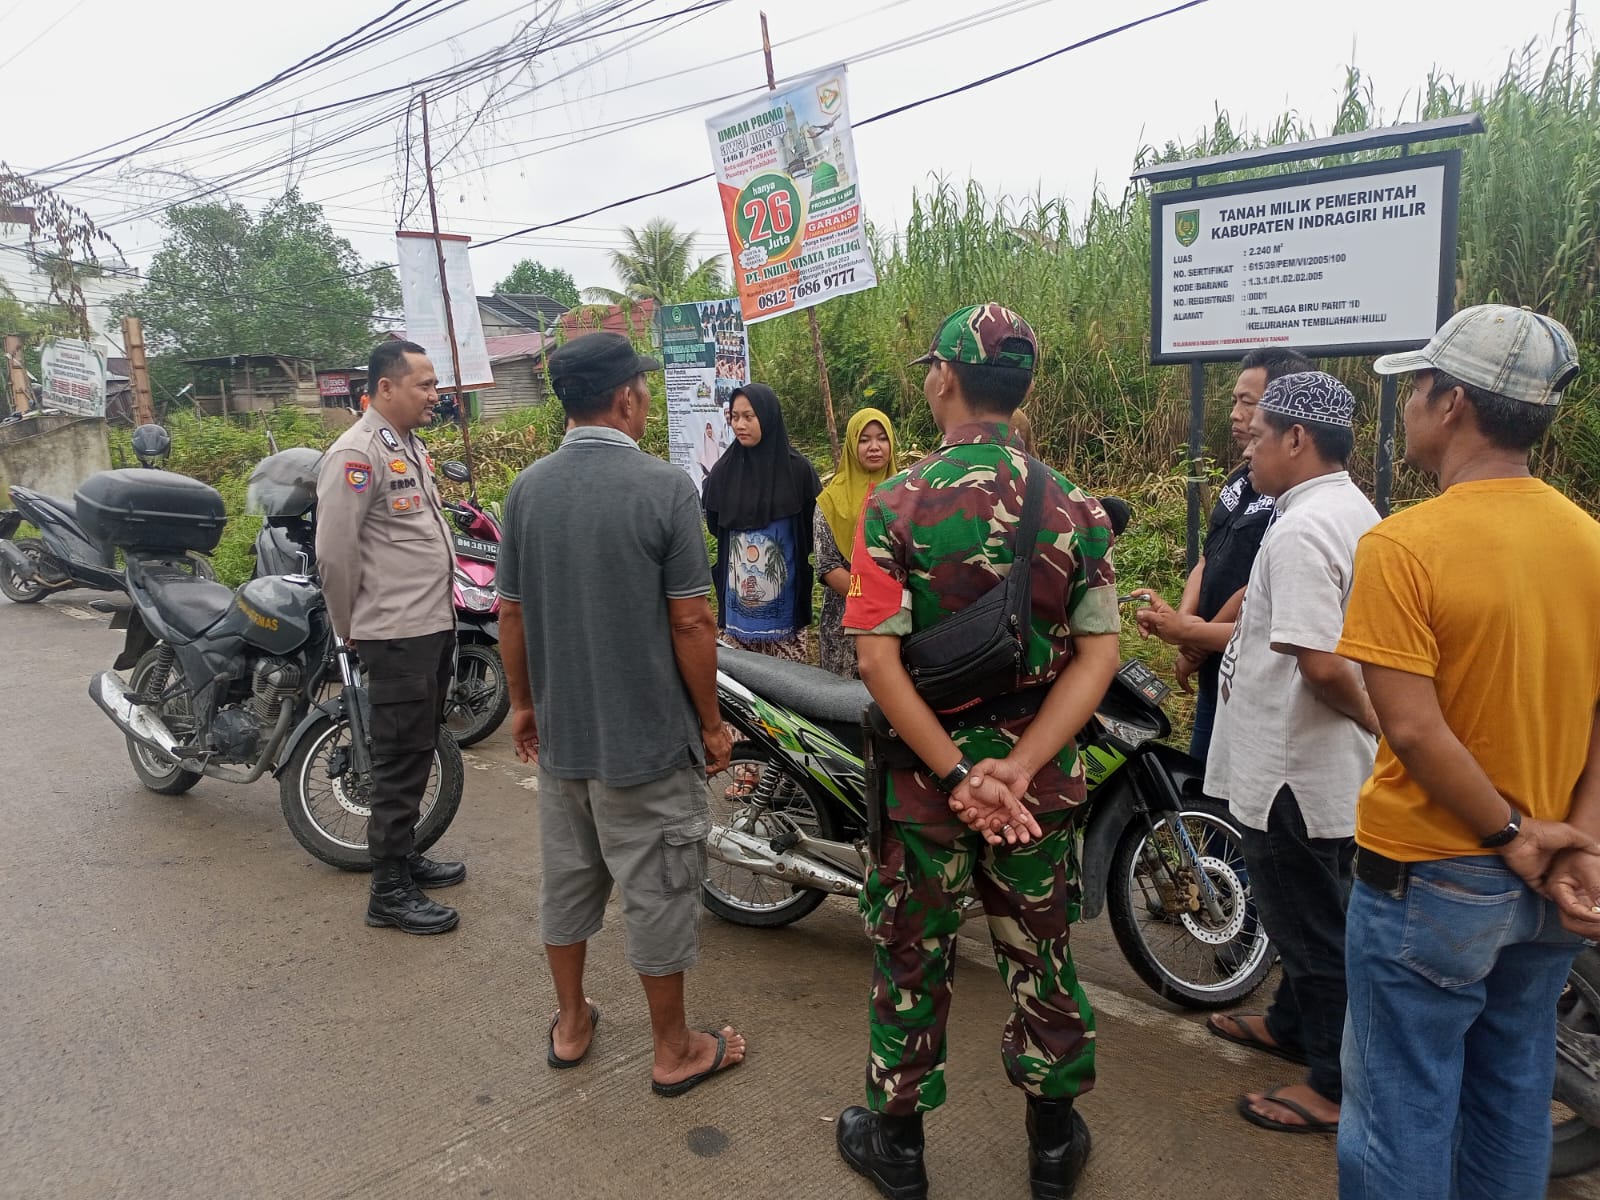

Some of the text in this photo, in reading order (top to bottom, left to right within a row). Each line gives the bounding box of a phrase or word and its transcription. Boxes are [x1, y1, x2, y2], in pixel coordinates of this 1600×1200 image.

[717, 106, 784, 143] UMRAH PROMO
[749, 121, 787, 145] musim
[752, 182, 776, 196] hanya
[811, 196, 837, 210] PROGRAM
[1219, 184, 1417, 222] TANAH MILIK PEMERINTAH
[743, 189, 793, 244] 26
[808, 208, 856, 232] GARANSI
[1211, 202, 1426, 240] KABUPATEN INDRAGIRI HILIR
[768, 235, 790, 250] Juta
[745, 271, 761, 285] PT.
[763, 262, 789, 280] INHIL
[791, 250, 824, 271] WISATA
[827, 239, 861, 258] RELIGI
[1173, 254, 1193, 264] LUAS
[1248, 245, 1271, 256] 2.240
[1173, 270, 1187, 278] NO.
[1187, 264, 1235, 277] SERTIFIKAT
[758, 289, 787, 309] 0812
[790, 279, 821, 301] 7686
[823, 268, 855, 290] 9777
[1173, 283, 1194, 293] KODE
[1195, 280, 1229, 291] BARANG
[1188, 294, 1235, 306] REGISTRASI
[1173, 311, 1204, 321] ALAMAT
[1262, 304, 1296, 315] TELAGA
[1298, 303, 1319, 312] BIRU
[1321, 300, 1347, 310] PARIT
[1247, 313, 1387, 330] KELURAHAN TEMBILAHAN HULU
[390, 478, 417, 490] ERDO
[457, 538, 470, 547] BM
